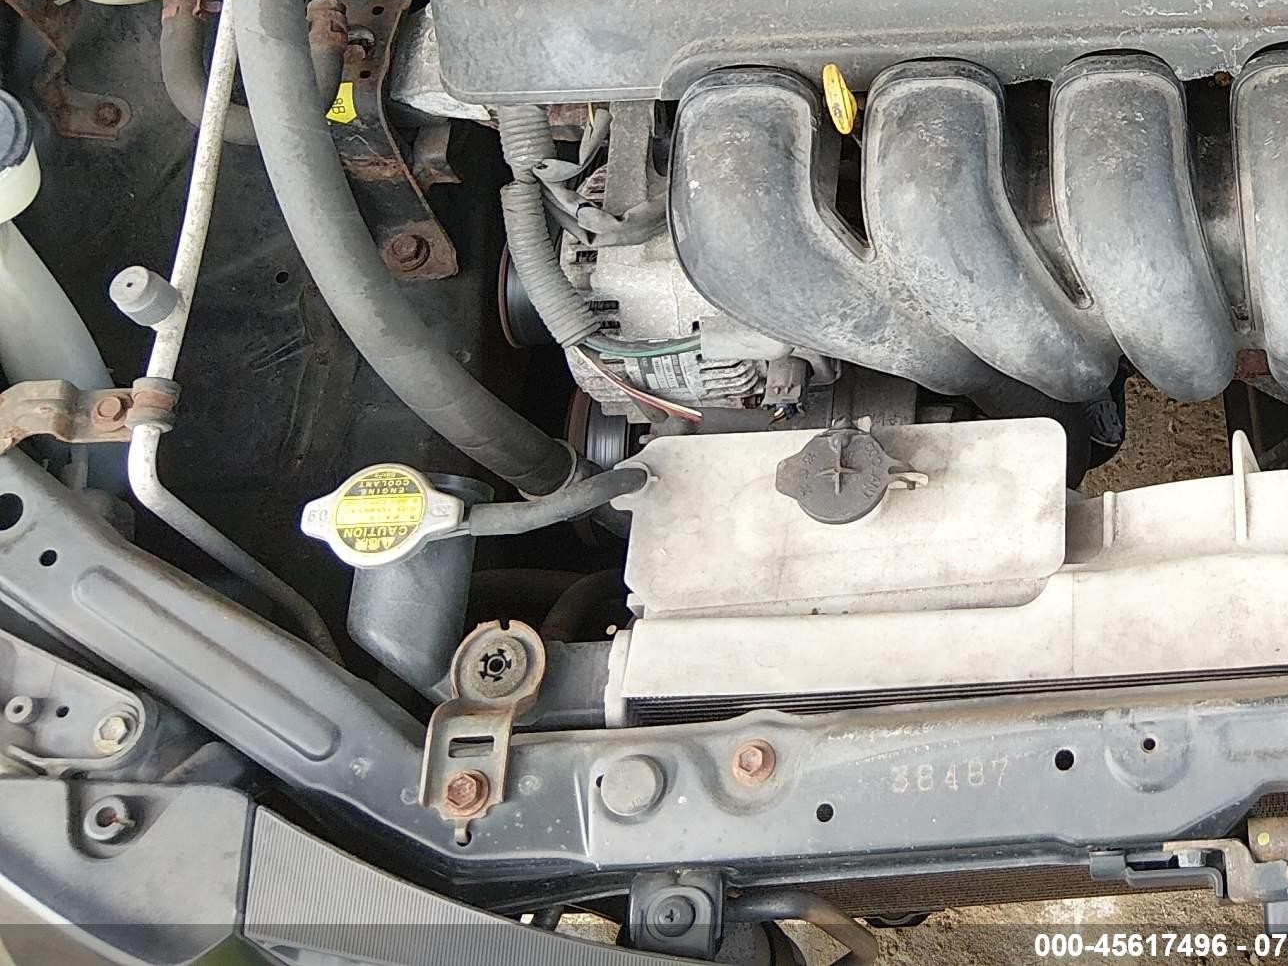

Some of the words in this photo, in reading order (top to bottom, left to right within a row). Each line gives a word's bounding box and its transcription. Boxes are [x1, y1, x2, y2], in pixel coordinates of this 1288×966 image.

[358, 479, 410, 488] COOLANT
[360, 487, 406, 495] ENGINE
[343, 526, 408, 539] CAUTION
